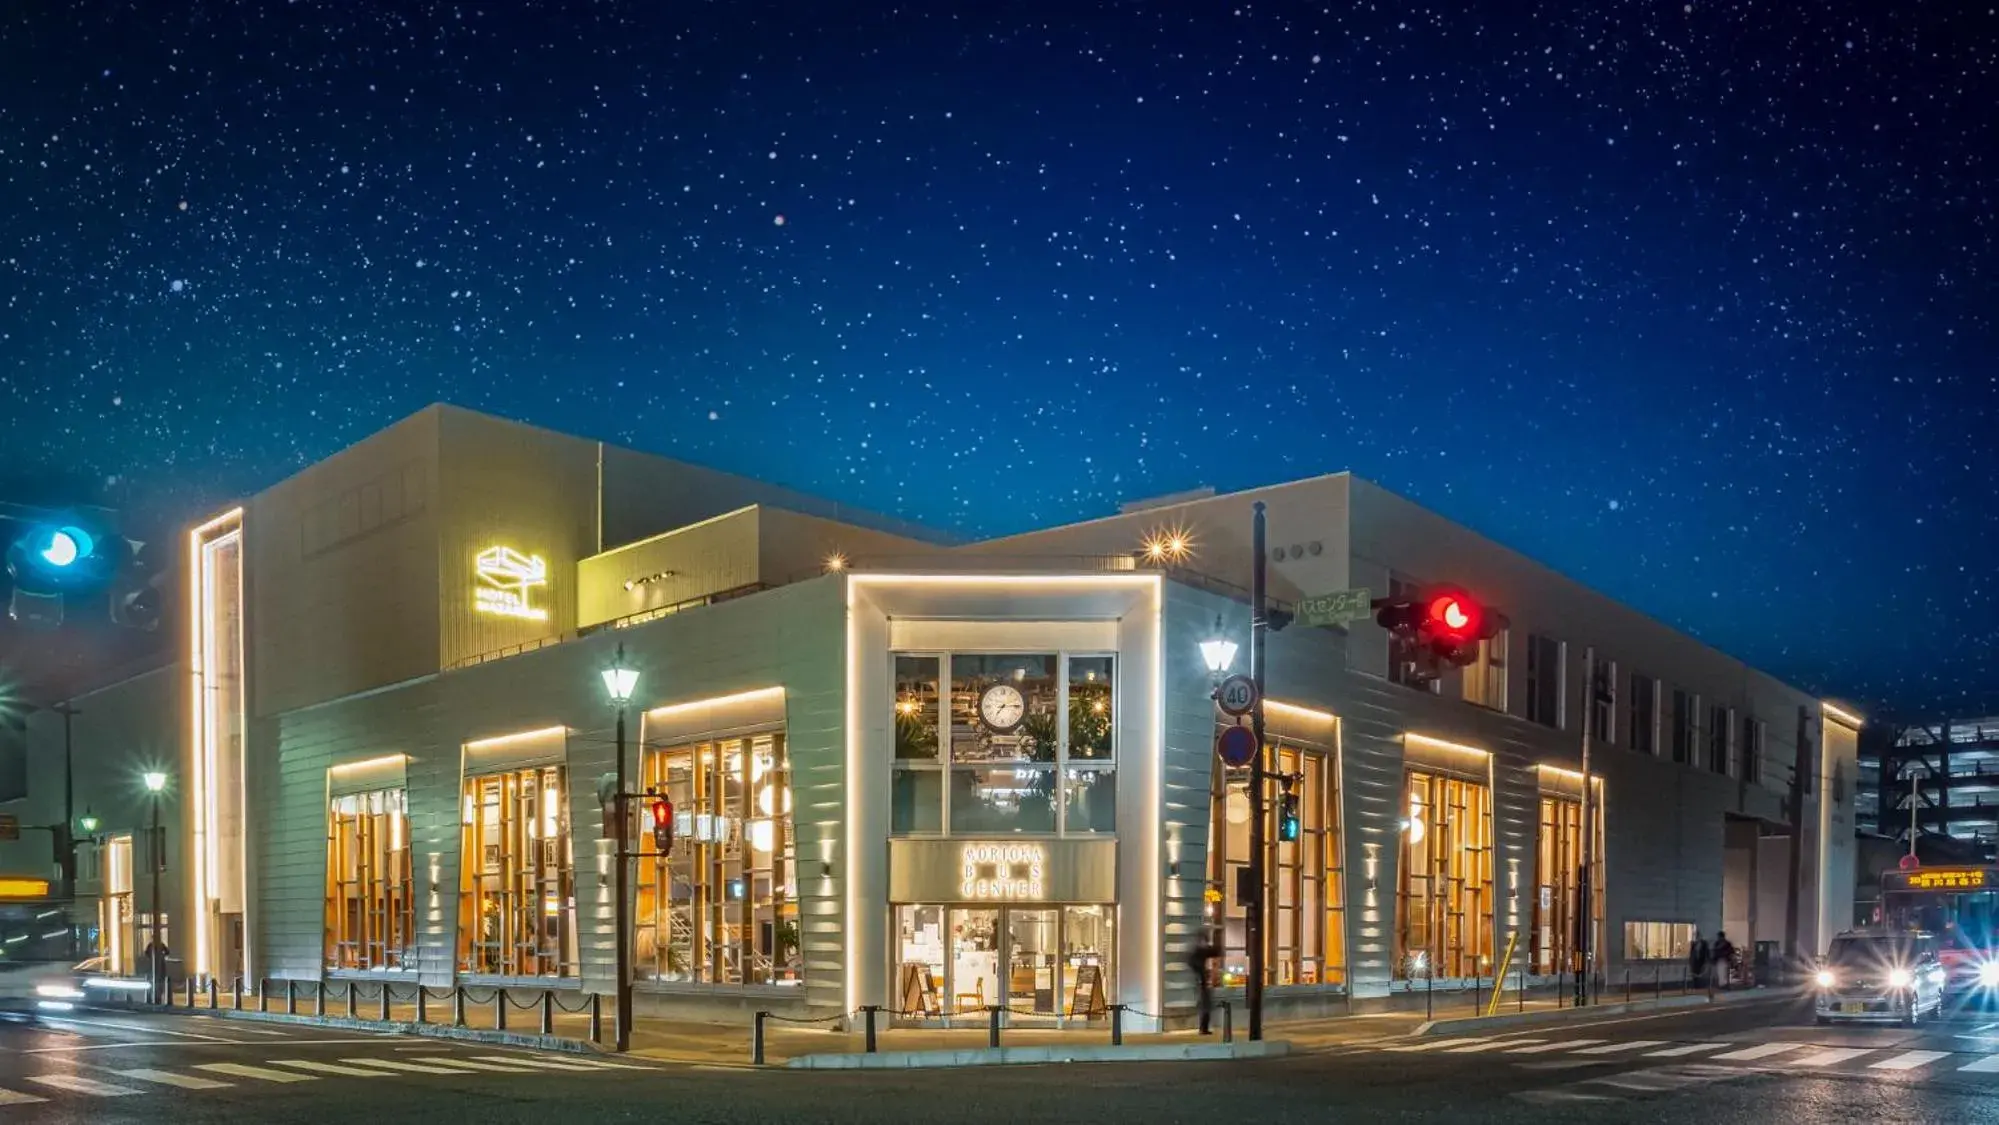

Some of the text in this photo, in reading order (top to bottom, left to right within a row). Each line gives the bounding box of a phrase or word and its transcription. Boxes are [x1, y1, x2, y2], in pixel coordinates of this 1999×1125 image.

[1227, 686, 1248, 704] 40
[964, 845, 1042, 862] MORIOKA
[963, 881, 1042, 897] CENTER
